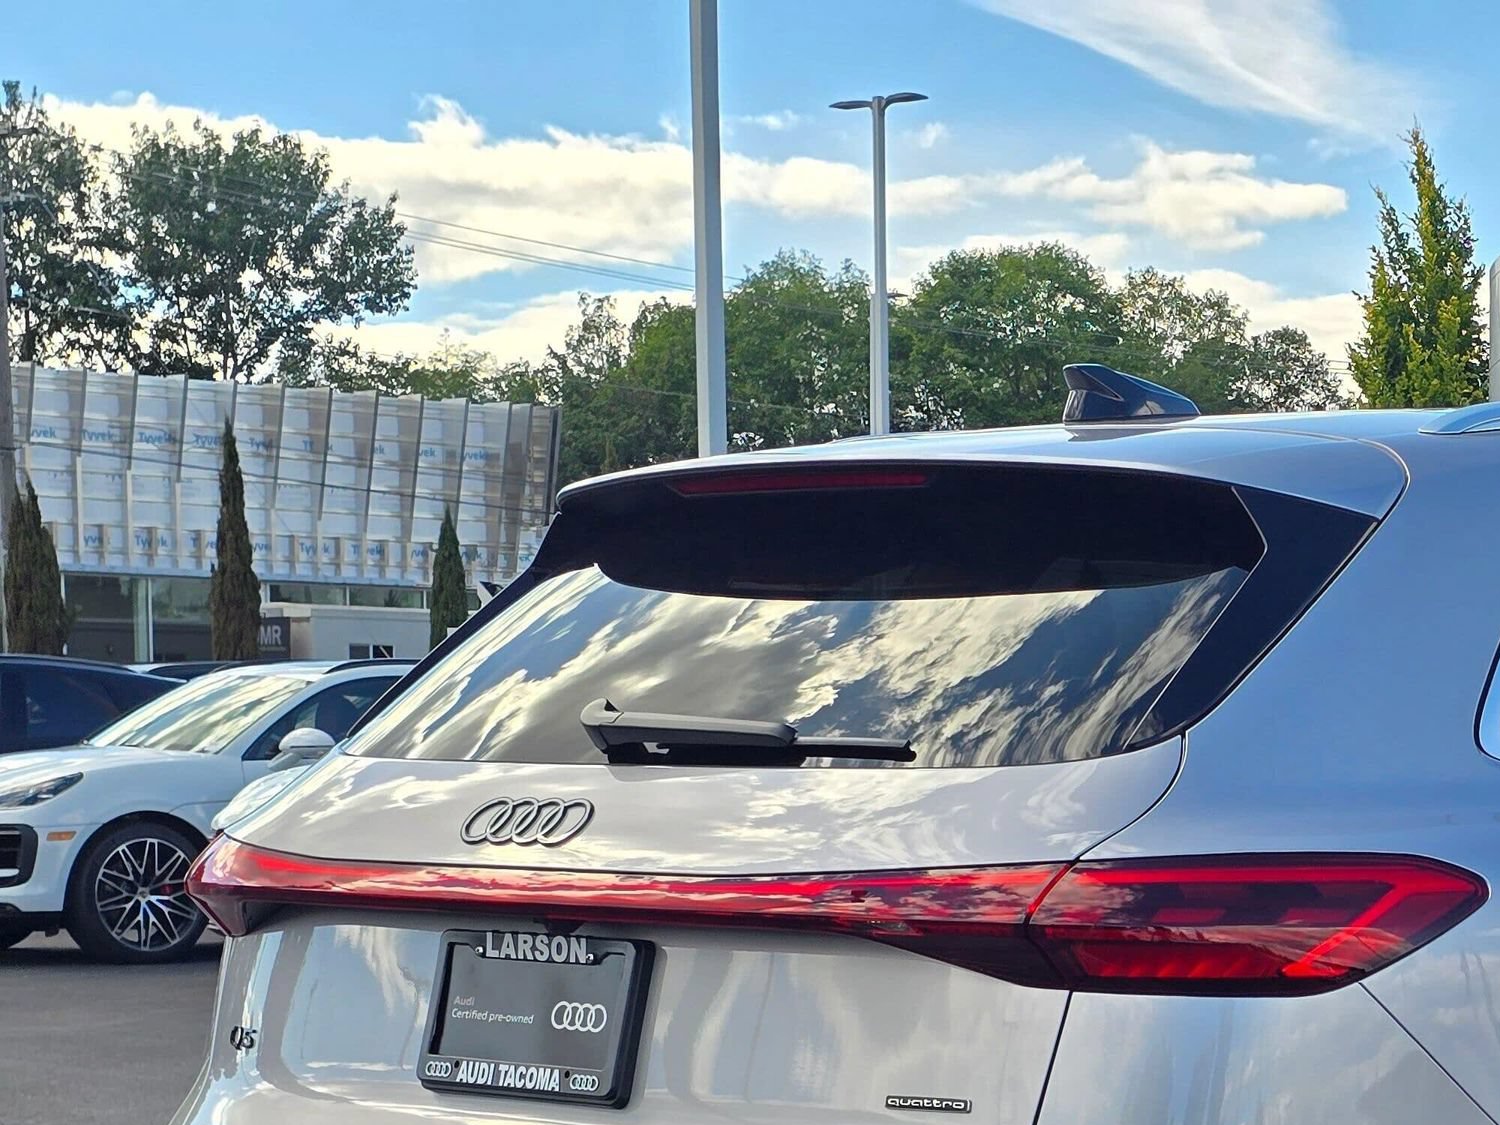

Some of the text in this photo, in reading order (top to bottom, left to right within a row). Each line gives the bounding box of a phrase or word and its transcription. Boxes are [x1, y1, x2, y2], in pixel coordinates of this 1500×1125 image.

[257, 624, 281, 646] MR
[485, 931, 588, 964] LARSON
[453, 996, 475, 1006] Audi
[451, 1008, 535, 1025] Certified pre-owned
[230, 1025, 257, 1051] Q5
[456, 1060, 561, 1092] AUDI TACOMA
[887, 1097, 965, 1110] quattro
